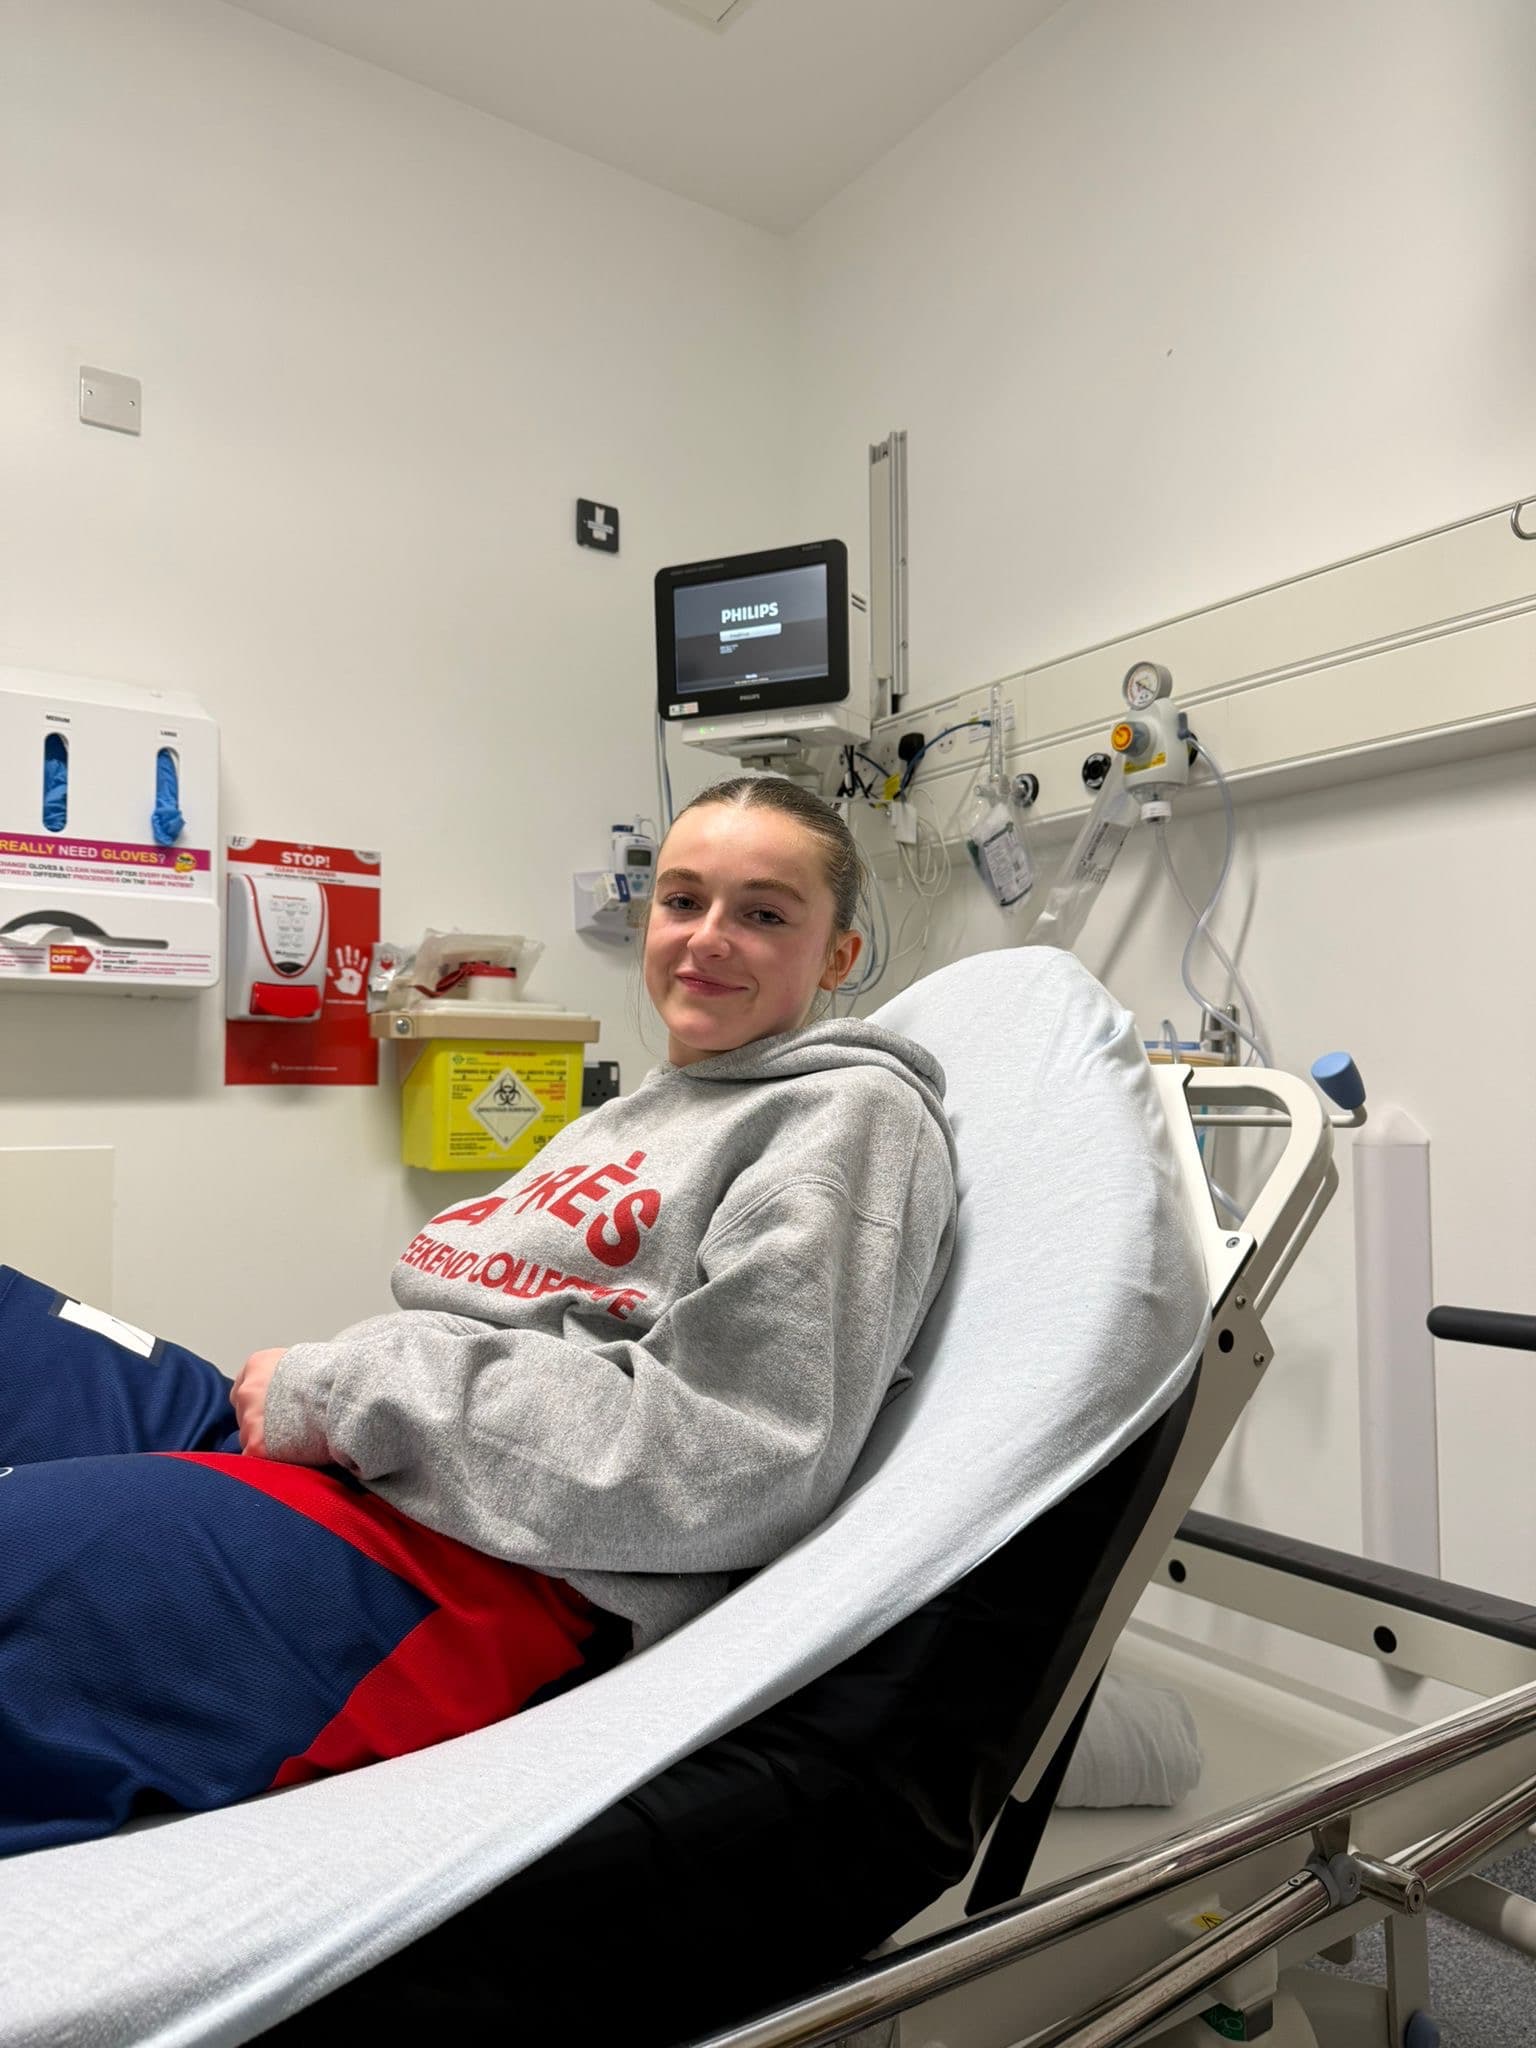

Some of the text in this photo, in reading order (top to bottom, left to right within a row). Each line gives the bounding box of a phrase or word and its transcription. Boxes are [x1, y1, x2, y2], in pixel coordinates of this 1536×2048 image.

[721, 602, 779, 624] PHILIPS
[0, 840, 167, 865] REALLY NEED GLOVES?
[281, 851, 330, 868] STOP!
[28, 863, 58, 871] GLOVES
[33, 871, 72, 879] DIFFERENT
[51, 955, 74, 964] OFF
[400, 1233, 480, 1280] EEKEND
